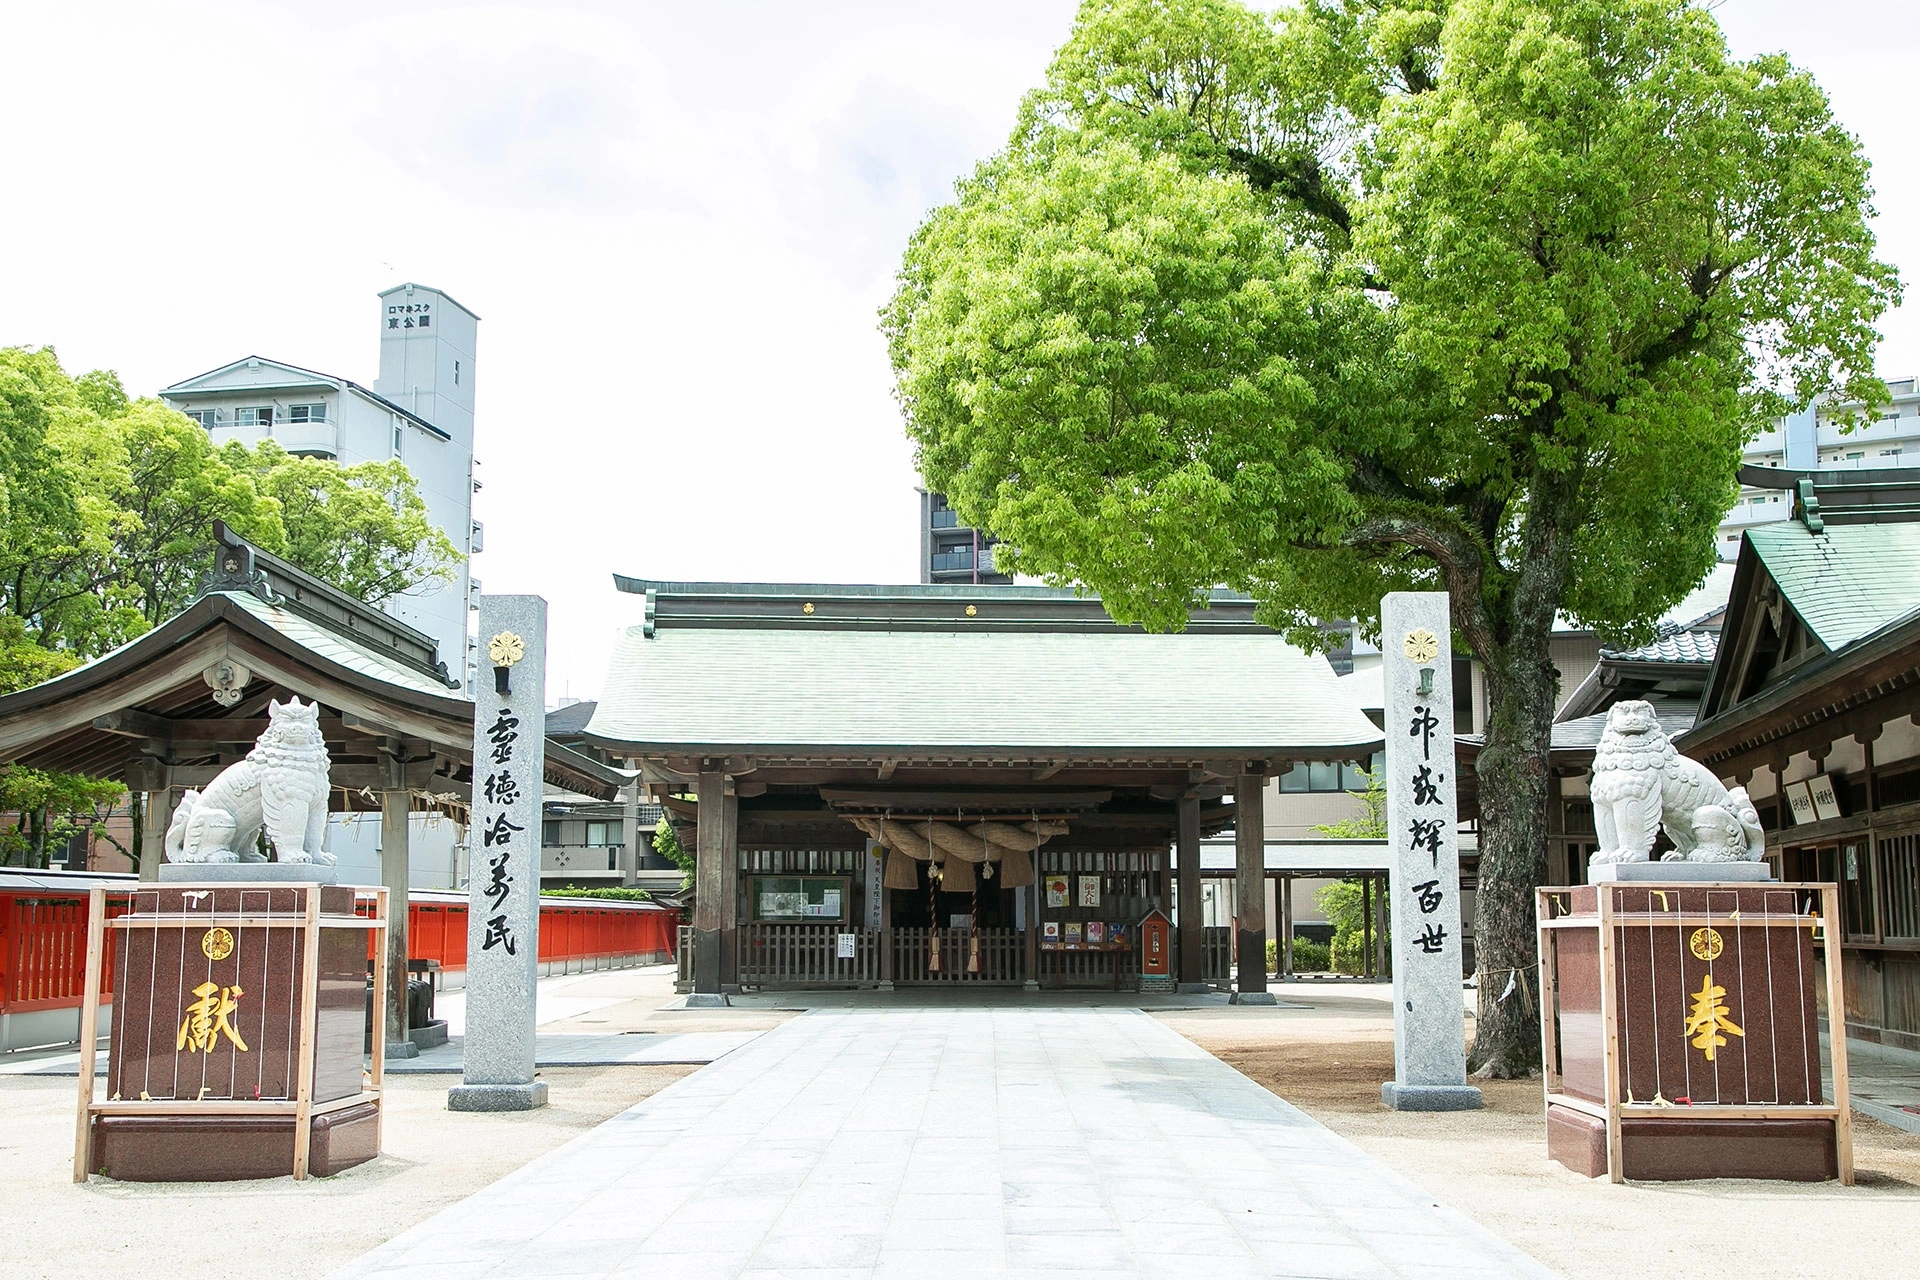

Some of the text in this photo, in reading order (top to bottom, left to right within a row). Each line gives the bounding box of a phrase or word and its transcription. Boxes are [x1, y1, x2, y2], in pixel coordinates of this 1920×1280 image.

[388, 303, 430, 314] ロマネスク
[388, 315, 430, 330] 東公園
[1683, 973, 1746, 1061] 奉
